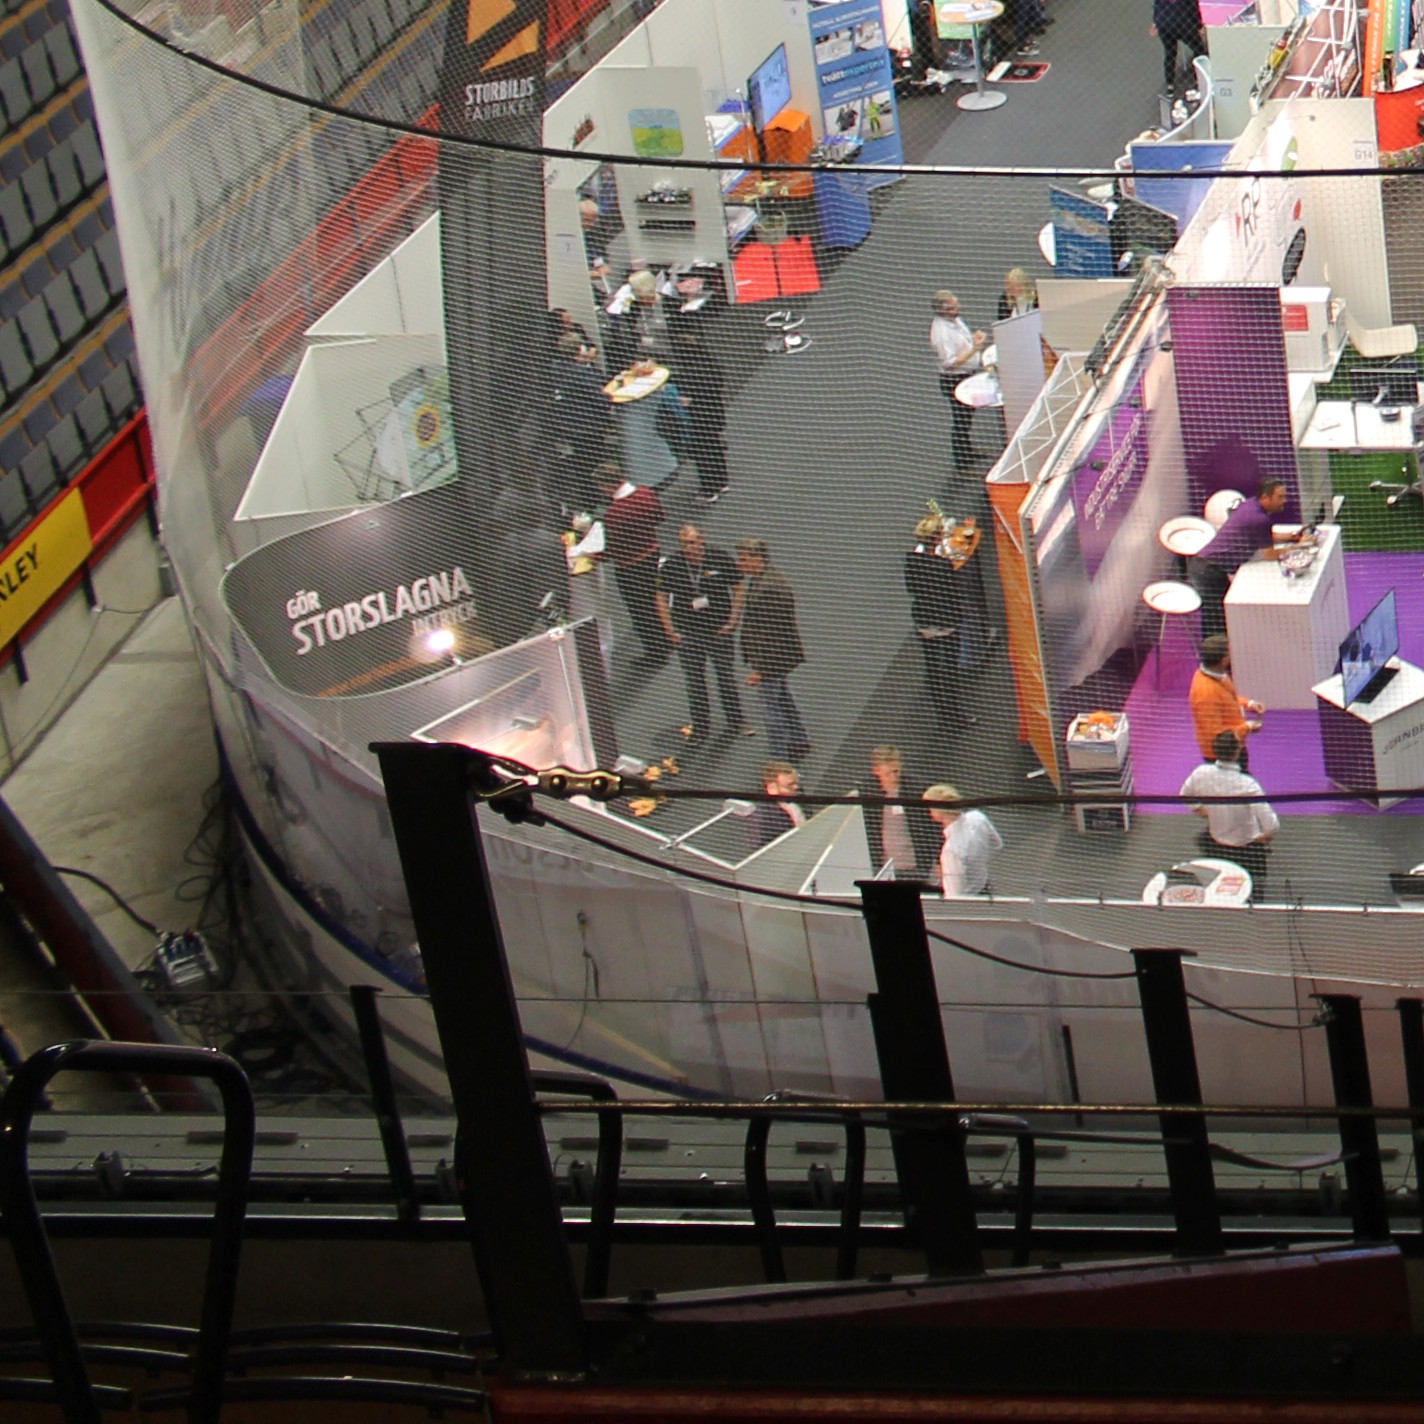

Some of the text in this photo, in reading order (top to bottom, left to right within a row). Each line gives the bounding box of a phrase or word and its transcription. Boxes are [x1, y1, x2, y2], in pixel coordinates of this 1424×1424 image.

[465, 76, 534, 106] STORBILDS
[1354, 149, 1373, 160] G14
[286, 588, 321, 620] GÖR
[291, 566, 473, 656] STORSLAGNA
